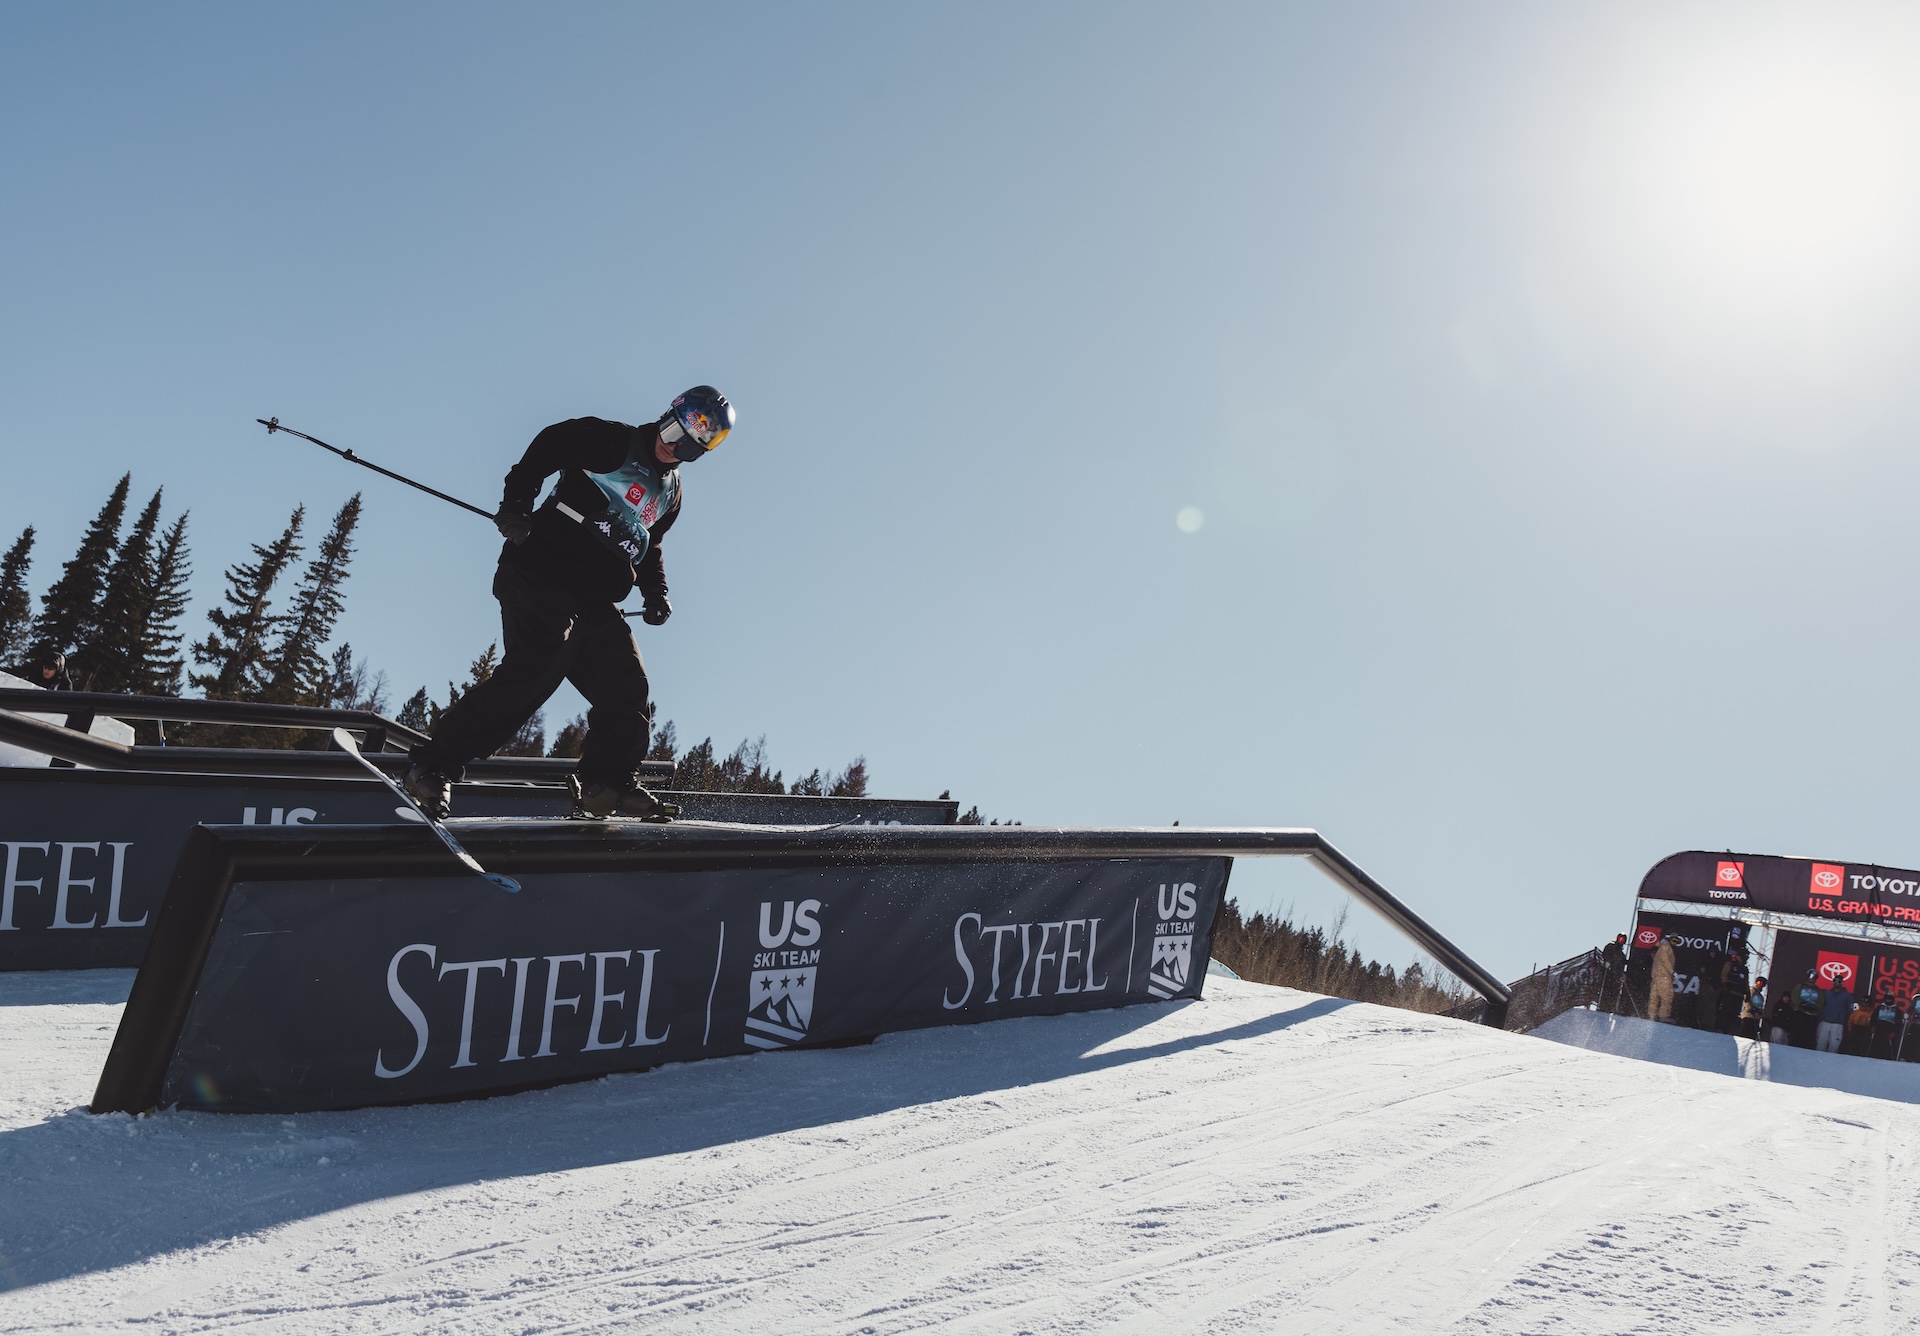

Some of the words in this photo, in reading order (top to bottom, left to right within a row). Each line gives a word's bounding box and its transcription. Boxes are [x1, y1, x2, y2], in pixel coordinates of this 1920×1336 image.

[1157, 882, 1197, 920] US
[1708, 890, 1747, 899] TOYOTA
[1808, 897, 1835, 912] U.S.
[1837, 900, 1892, 918] GRAND
[758, 899, 821, 949] US
[1155, 922, 1168, 935] SKI
[1170, 921, 1195, 934] TEAM
[1665, 934, 1722, 951] OYOTA
[753, 951, 776, 968] SKI
[780, 949, 820, 966] TEAM
[942, 912, 1109, 1010] STIFEL
[374, 943, 671, 1079] STIFEL
